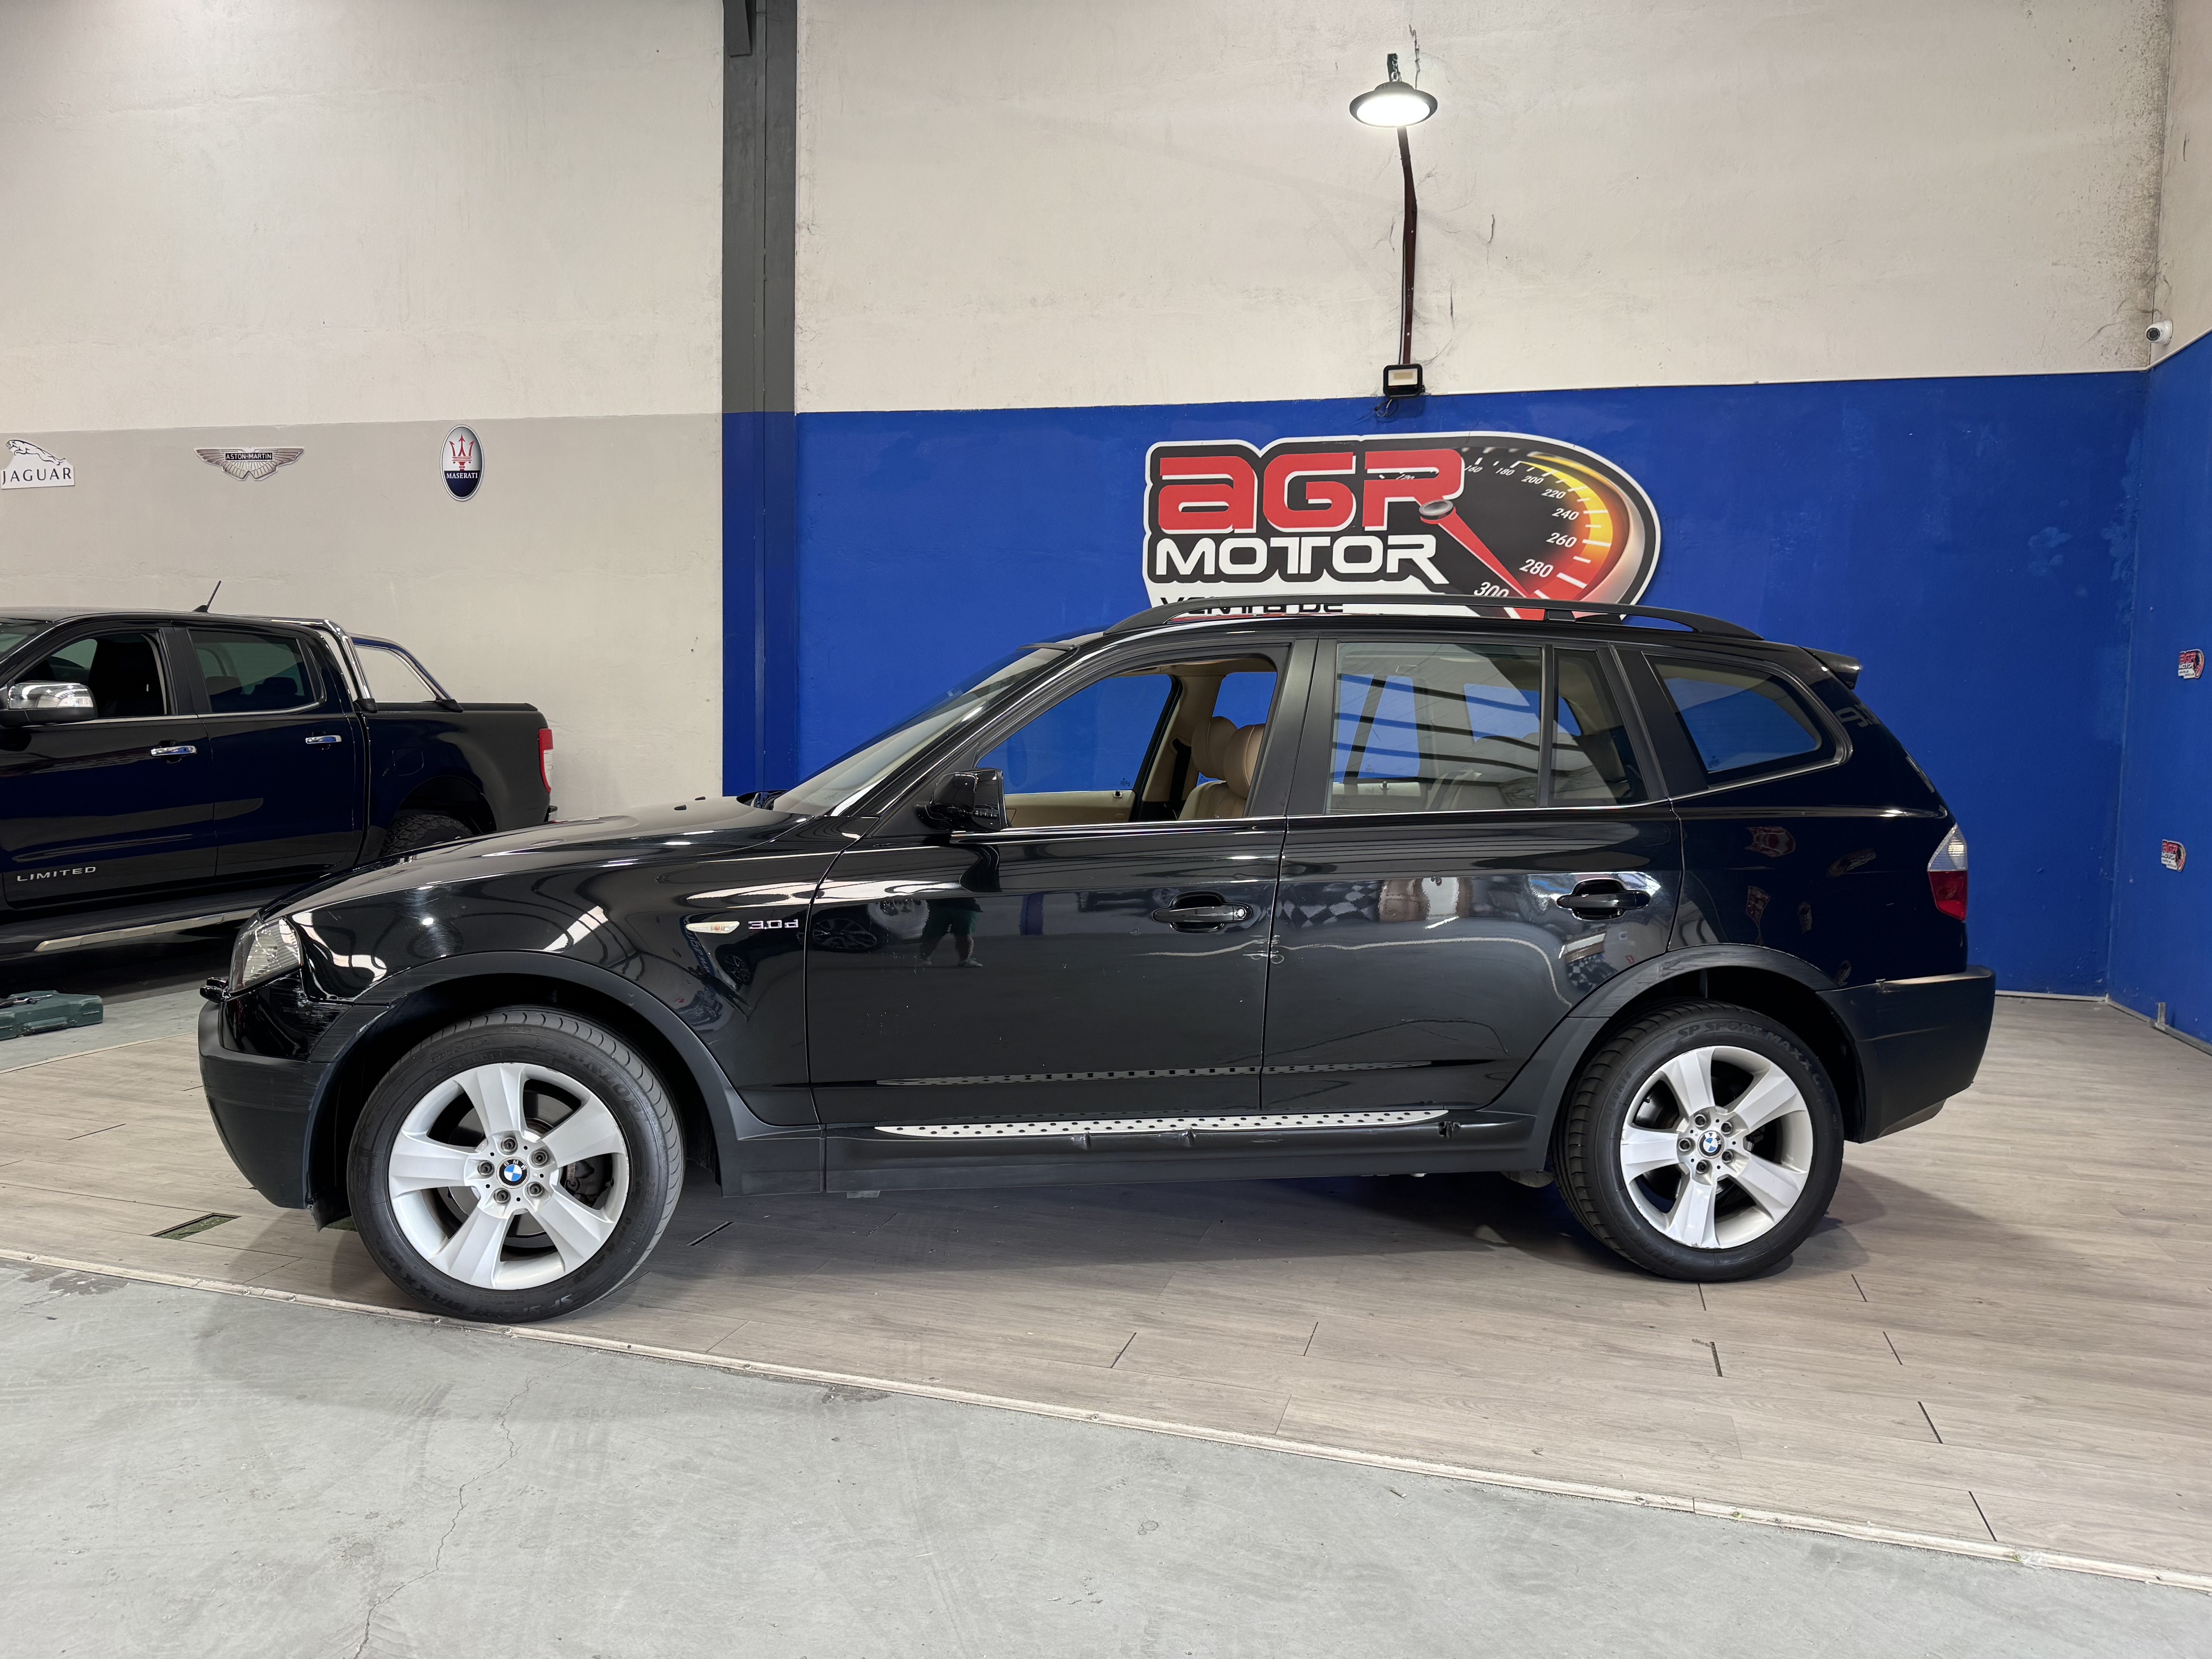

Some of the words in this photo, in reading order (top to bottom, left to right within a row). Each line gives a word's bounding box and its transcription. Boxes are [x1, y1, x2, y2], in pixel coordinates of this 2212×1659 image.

[2, 467, 72, 485] JAGUAR
[1464, 465, 1483, 473] 160
[1496, 467, 1515, 476] 180
[1521, 476, 1544, 485] 200
[1541, 489, 1566, 499] 220
[1552, 508, 1579, 520] 240
[1546, 532, 1577, 548] 260
[1156, 534, 1450, 584] MOTOR
[1519, 559, 1554, 578] 280
[1474, 581, 1510, 597] 300
[17, 866, 96, 881] LIMITED
[1678, 1024, 1700, 1038] SP
[1704, 1022, 1762, 1037] SPORT
[1766, 1032, 1812, 1071] MAXX
[503, 1159, 527, 1171] BMW
